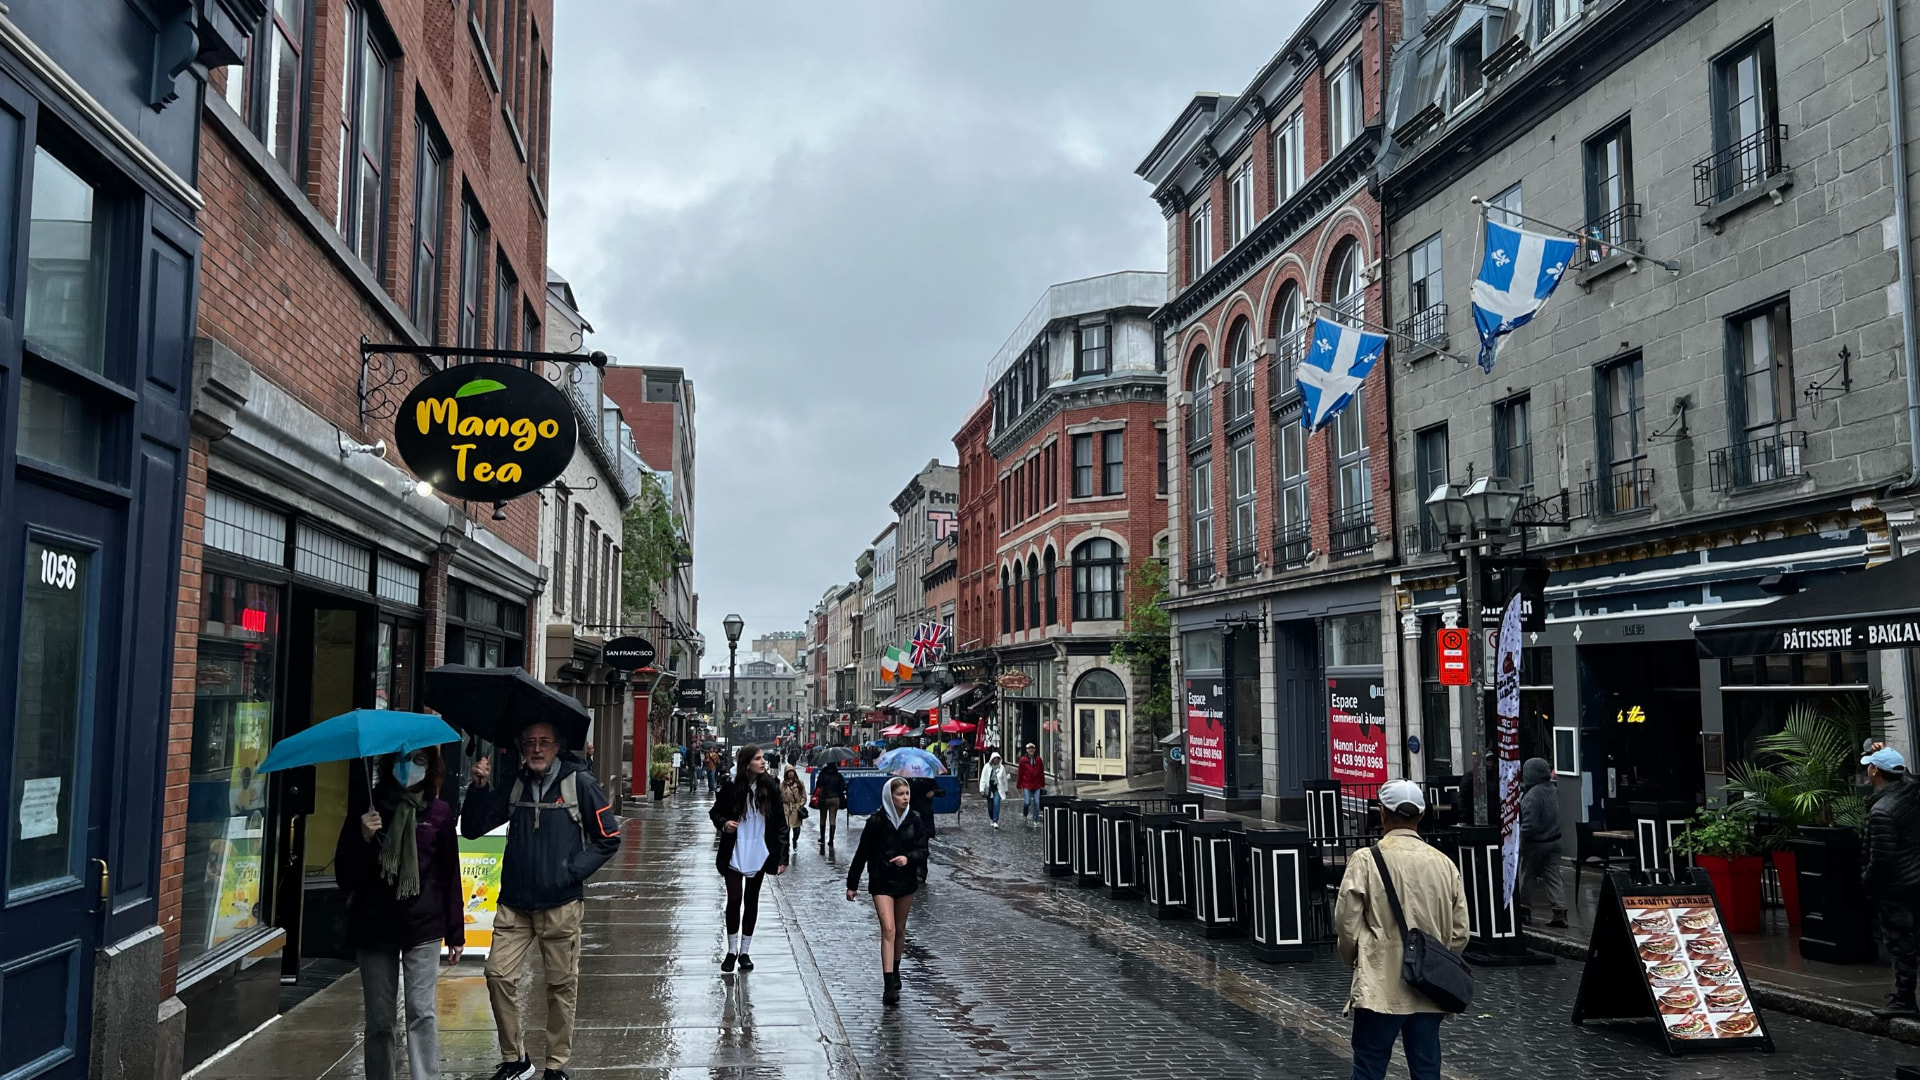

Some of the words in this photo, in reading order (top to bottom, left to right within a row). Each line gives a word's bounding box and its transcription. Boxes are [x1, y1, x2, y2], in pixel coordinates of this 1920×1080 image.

[416, 397, 559, 452] Mango
[451, 443, 522, 483] Tea
[41, 549, 77, 590] 1056
[1783, 627, 1852, 649] PÂTISSERIE
[1188, 692, 1206, 707] Espace
[1331, 693, 1358, 711] Espace
[1332, 712, 1364, 724] commercial
[1365, 711, 1369, 724] à
[1369, 713, 1385, 725] louer
[1333, 739, 1353, 751] Manon
[1333, 753, 1341, 765] +1
[1341, 754, 1354, 766] 438
[1354, 755, 1366, 767] 990
[1367, 756, 1384, 769] 8968
[460, 857, 497, 865] MANGO
